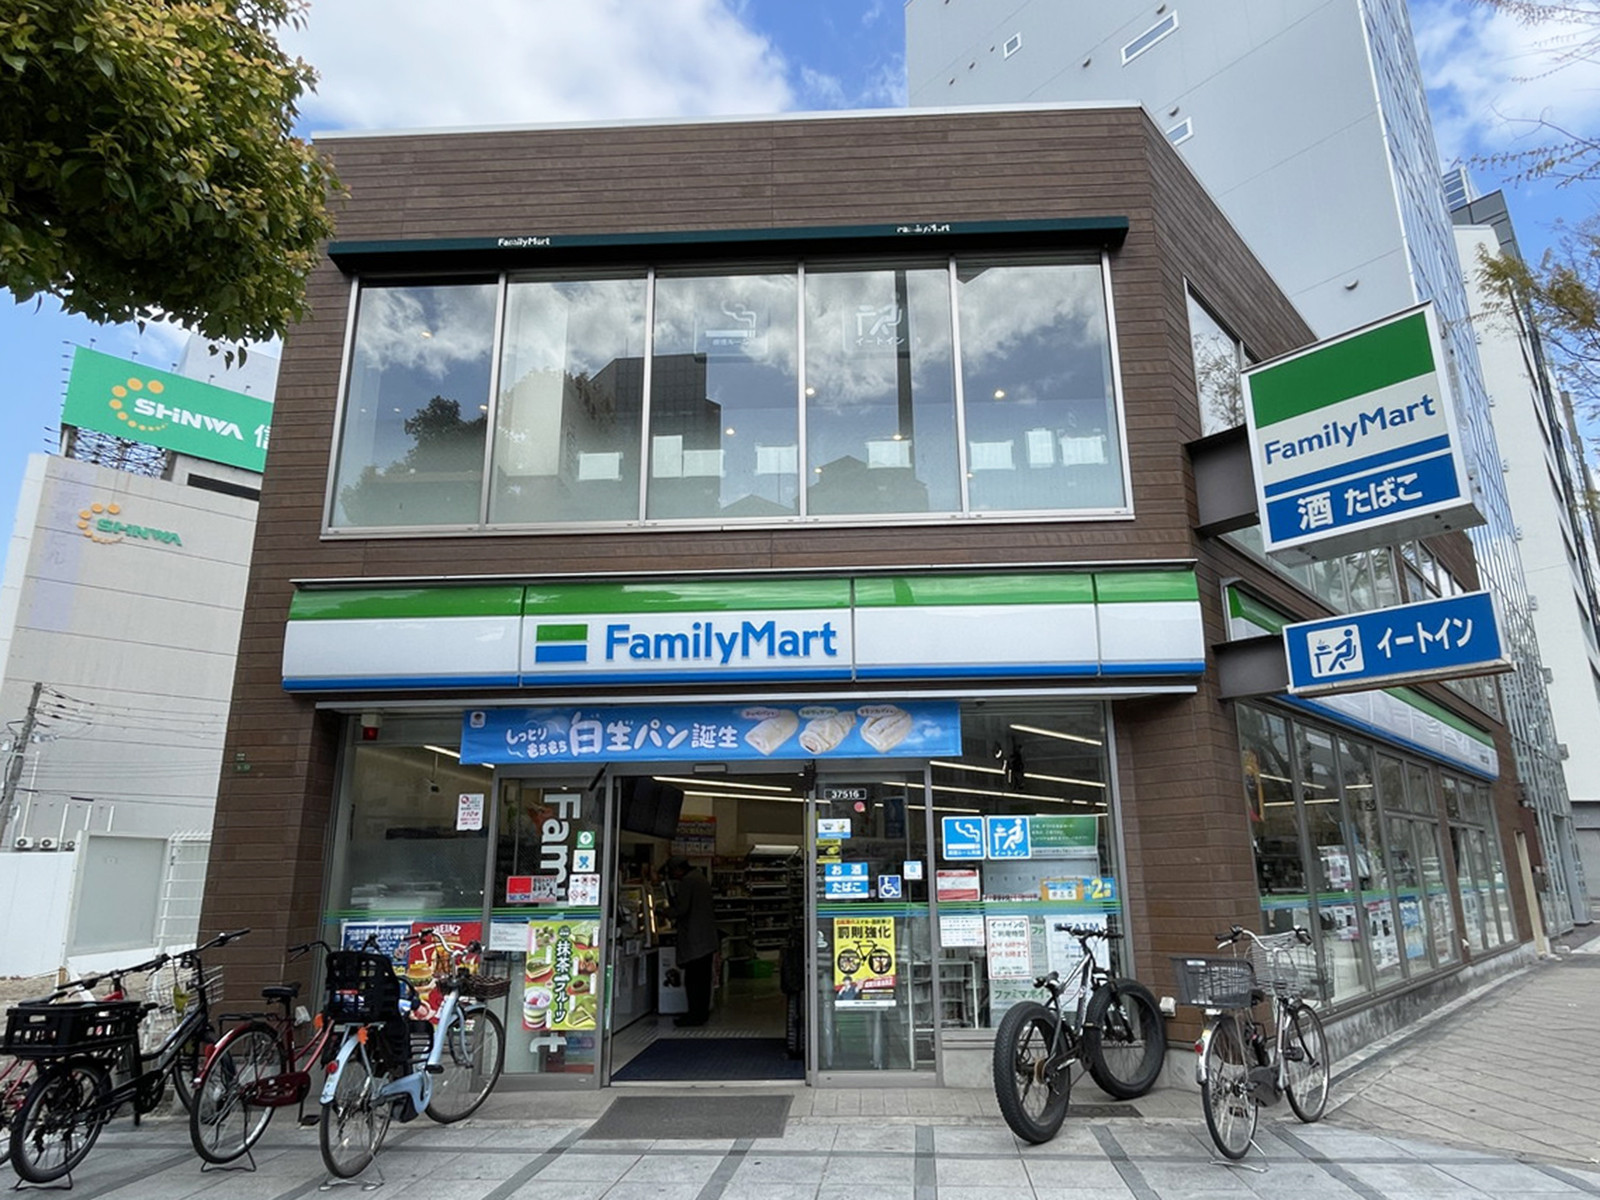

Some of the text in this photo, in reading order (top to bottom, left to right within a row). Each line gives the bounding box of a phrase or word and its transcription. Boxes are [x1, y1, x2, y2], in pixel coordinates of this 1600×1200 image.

[133, 397, 244, 441] SHINWA
[1263, 394, 1437, 465] FamilyMart
[1297, 472, 1423, 531] 酒 たばこ
[96, 517, 183, 547] SHINWA
[605, 620, 838, 664] FamilyMart
[1376, 617, 1474, 659] イートイン
[505, 728, 548, 745] しっとり
[526, 740, 568, 759] もちもち
[831, 881, 862, 893] たばこ
